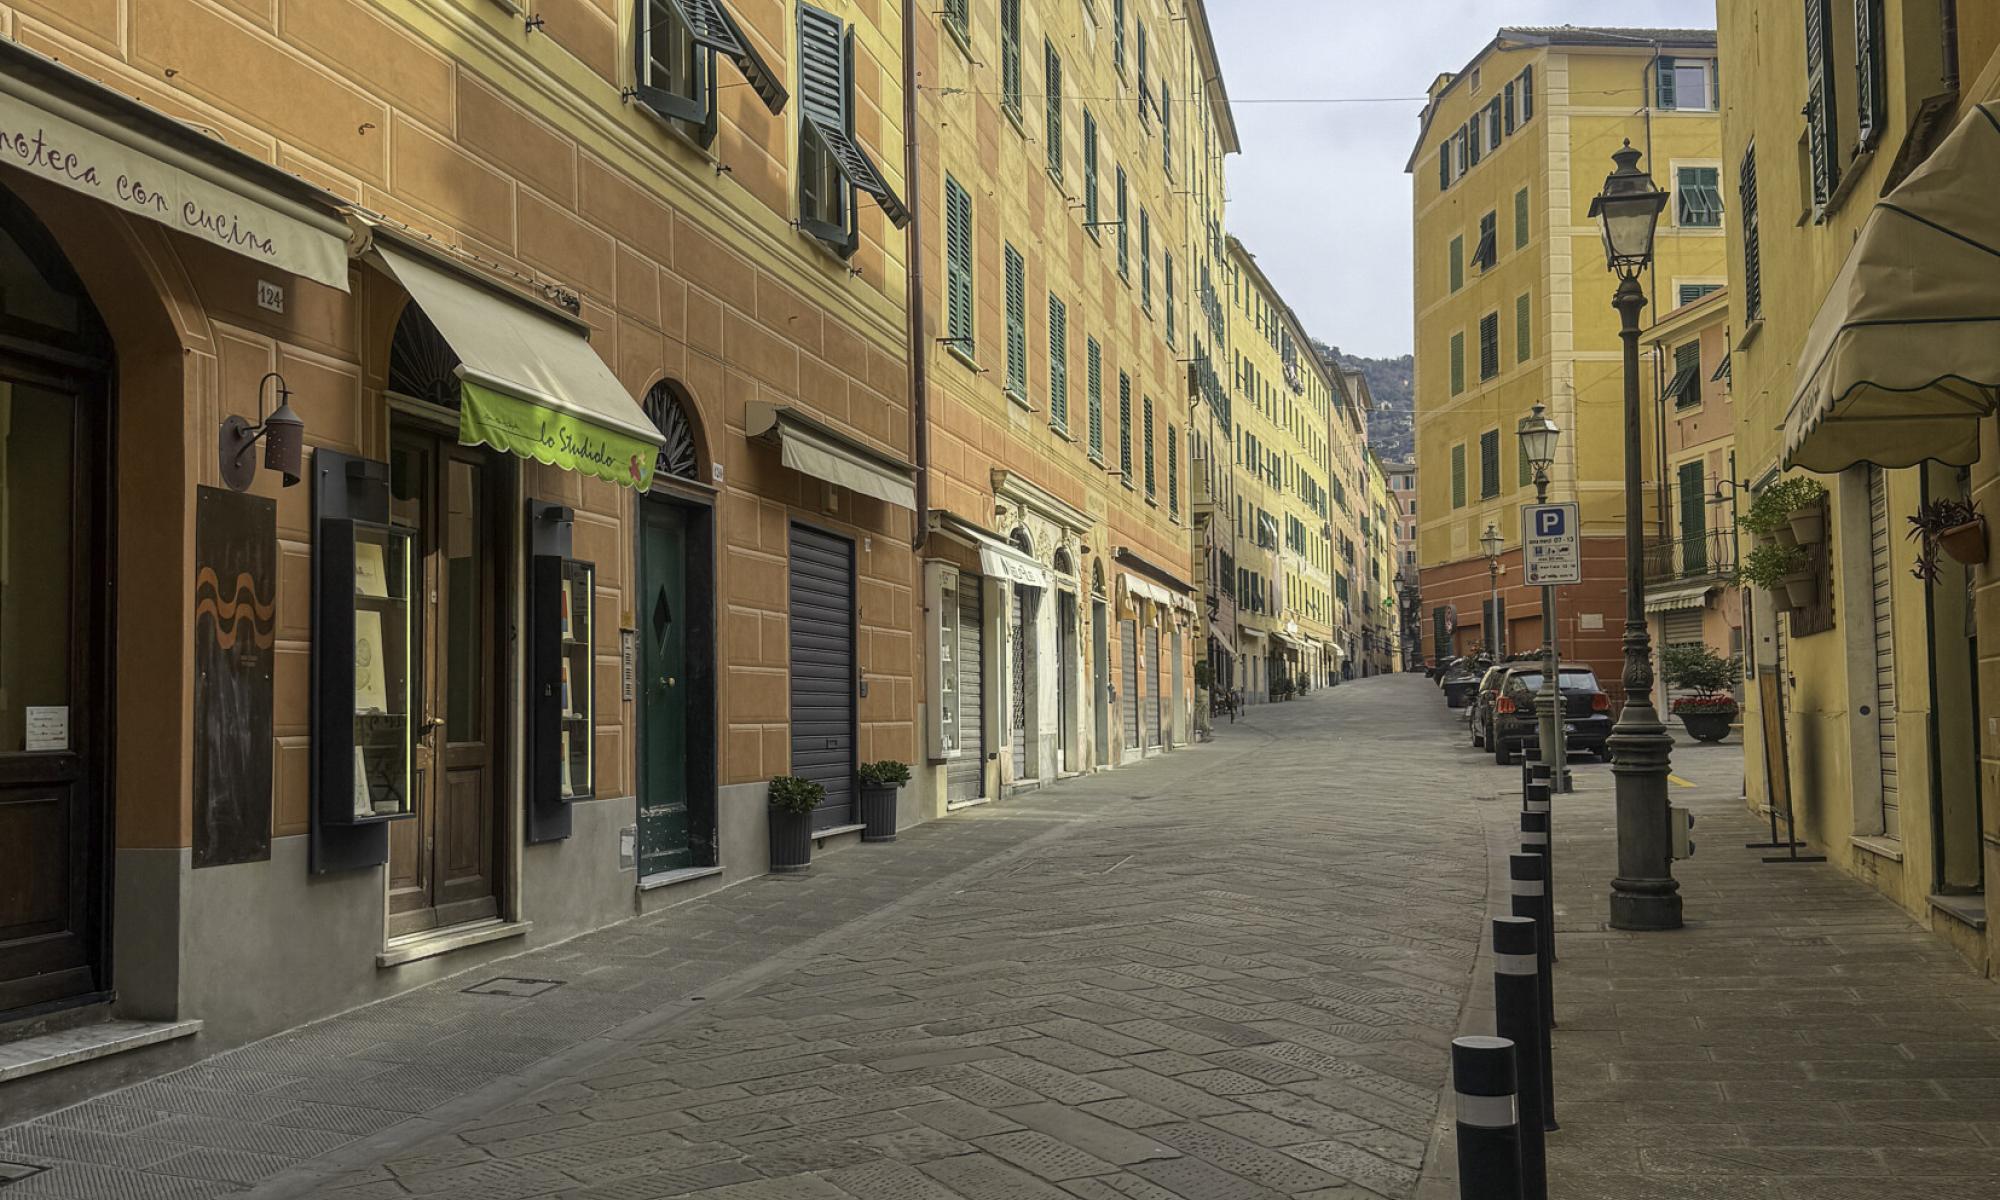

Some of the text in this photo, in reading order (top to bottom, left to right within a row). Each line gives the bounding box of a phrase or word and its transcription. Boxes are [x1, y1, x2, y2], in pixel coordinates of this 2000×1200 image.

[116, 174, 169, 212] con
[183, 201, 277, 256] cucina
[261, 286, 280, 308] 124
[559, 427, 616, 467] Studiolo
[1542, 513, 1559, 533] P
